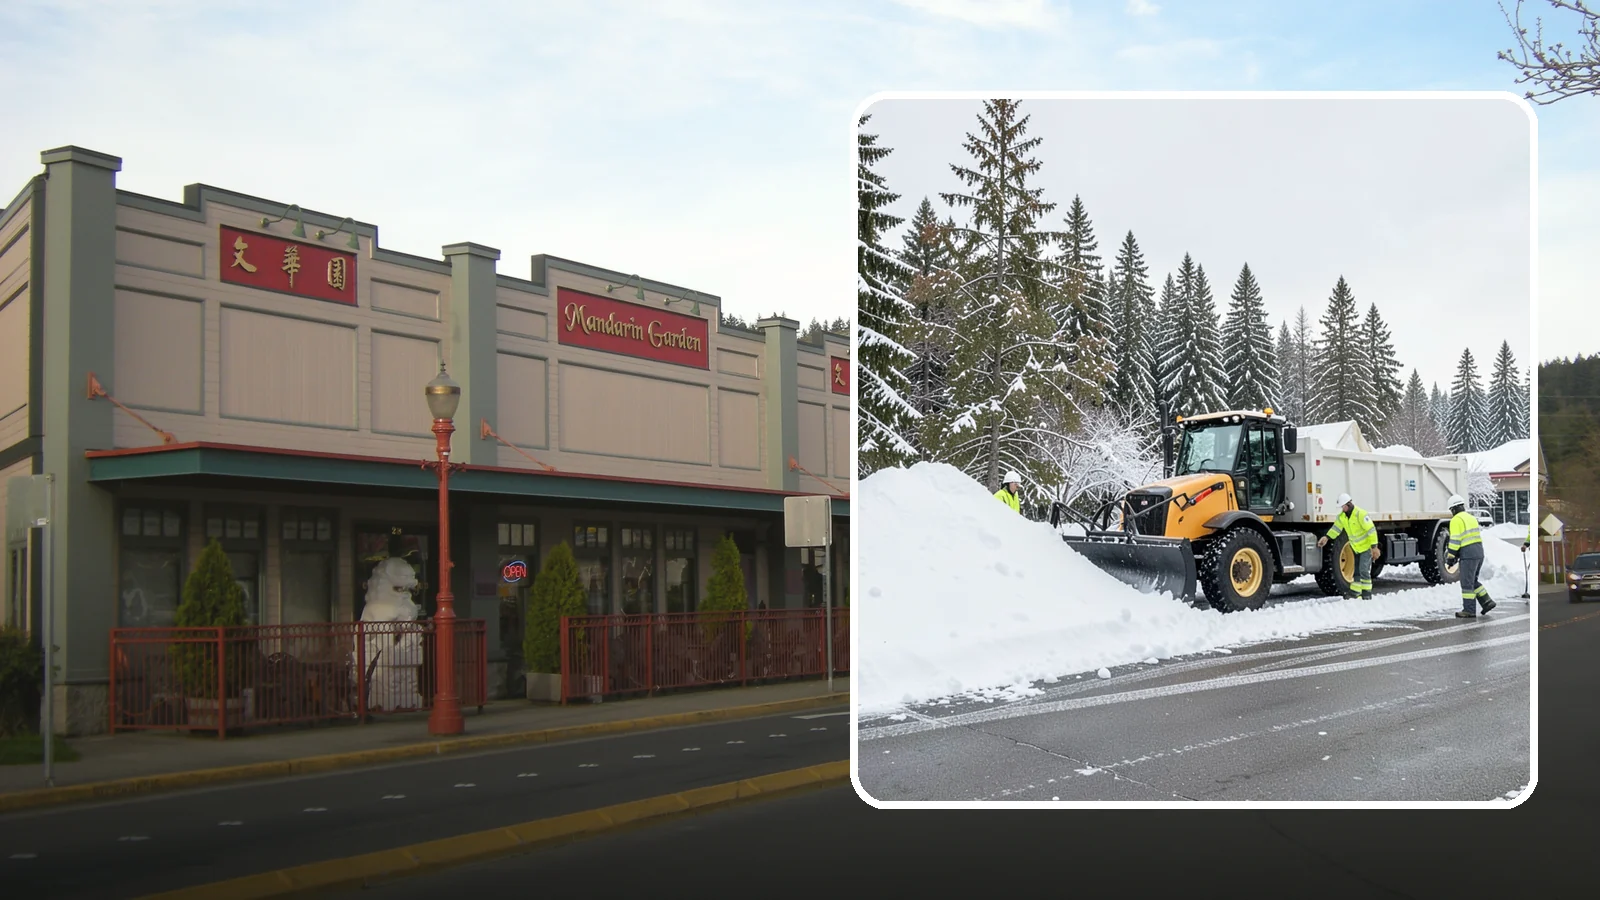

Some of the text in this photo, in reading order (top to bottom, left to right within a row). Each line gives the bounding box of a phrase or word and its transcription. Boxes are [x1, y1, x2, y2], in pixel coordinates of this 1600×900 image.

[230, 235, 346, 291] 文華園
[564, 302, 701, 352] Mandarin Garden
[503, 565, 527, 578] OPEN
